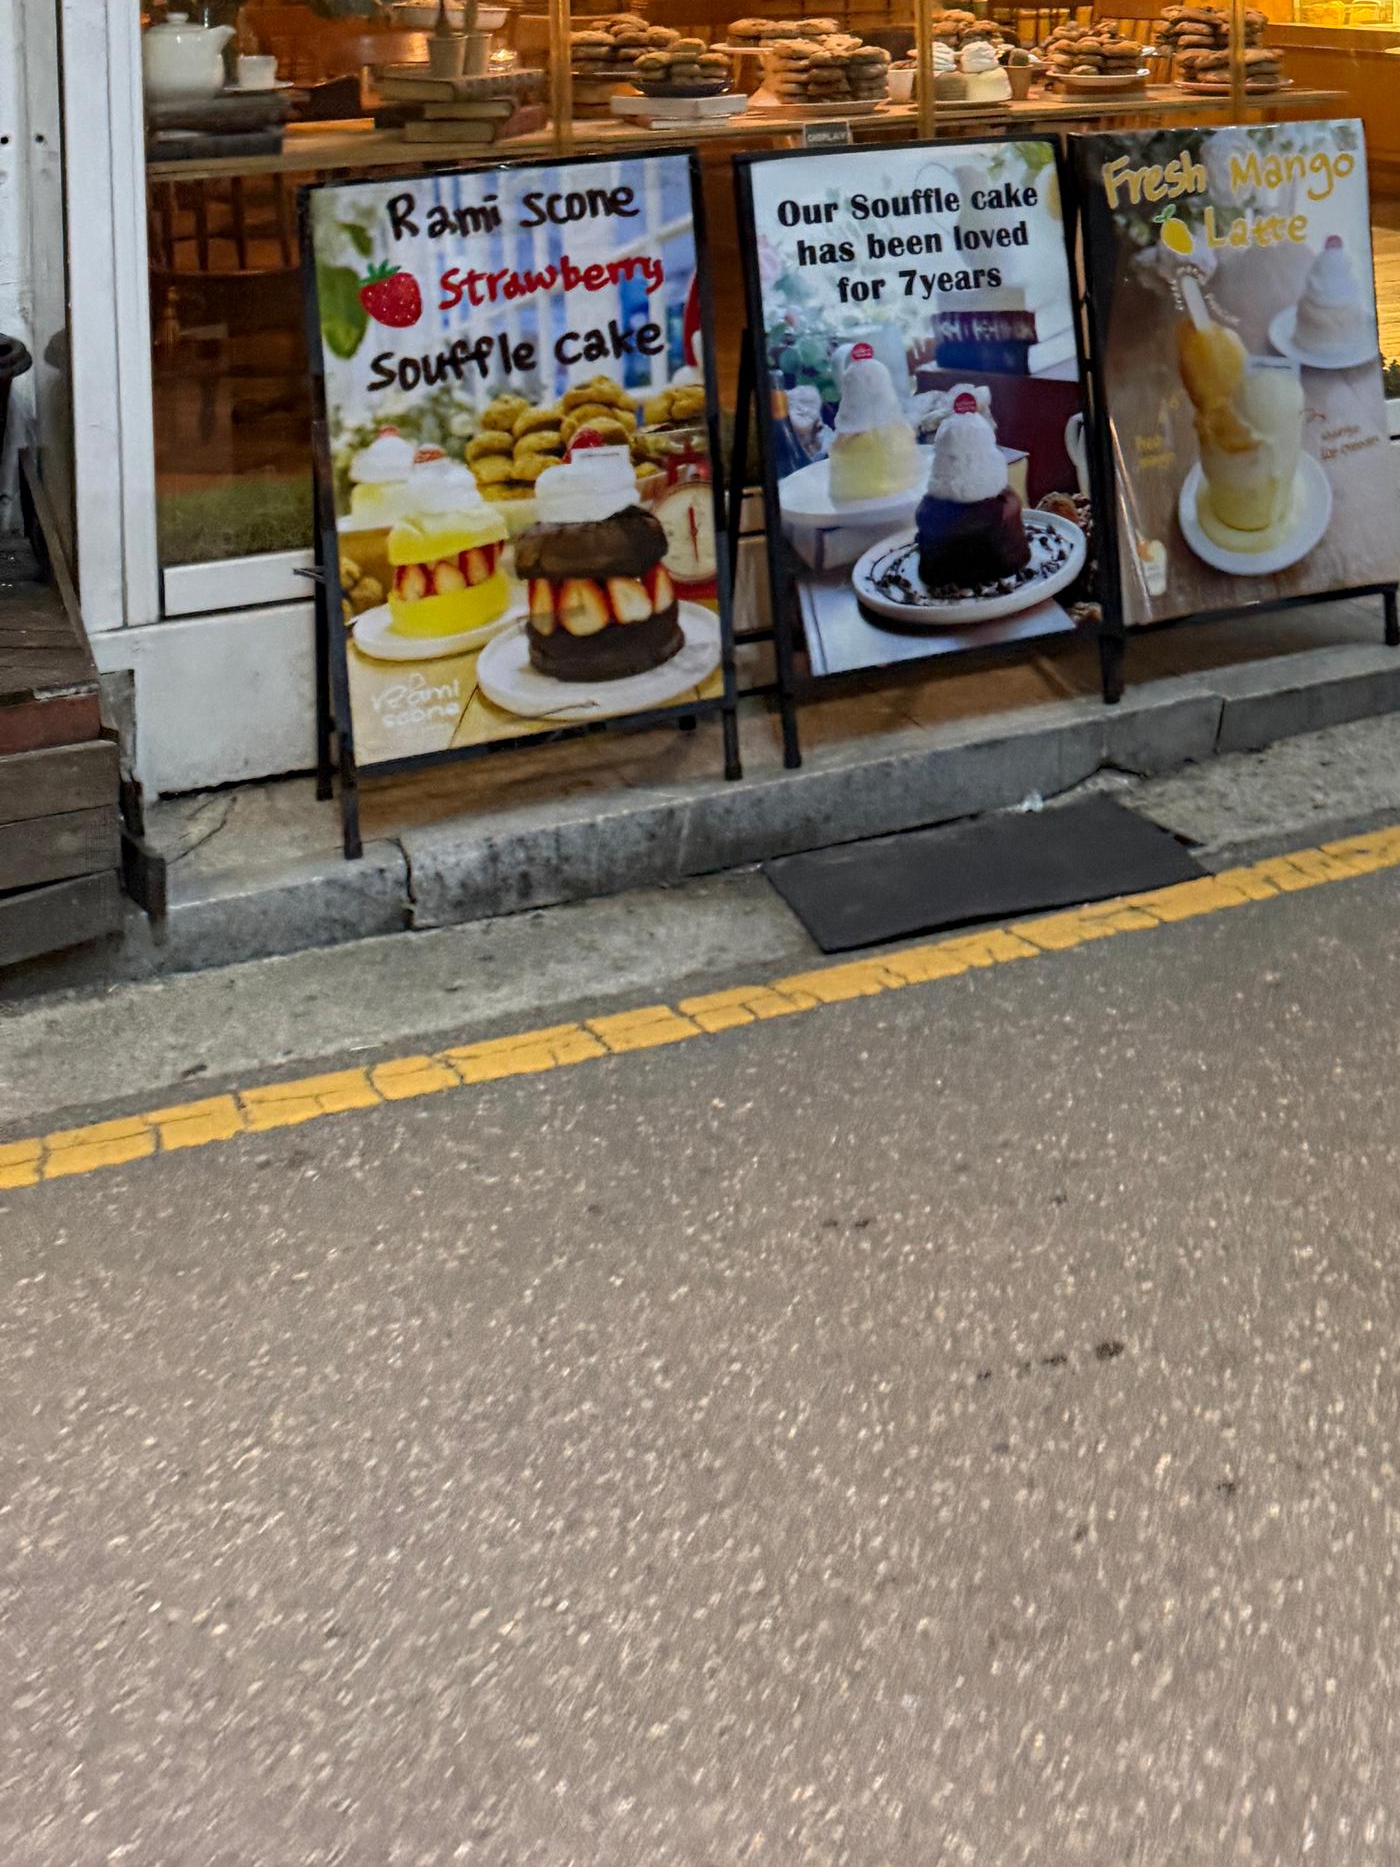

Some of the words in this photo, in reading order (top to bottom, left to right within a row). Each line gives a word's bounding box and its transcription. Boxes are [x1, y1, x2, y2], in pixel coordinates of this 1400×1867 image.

[1103, 149, 1206, 209] Fresh
[1229, 150, 1355, 201] Mango
[387, 192, 502, 241] Rami
[777, 199, 838, 227] Our
[851, 187, 960, 220] Souffle
[971, 182, 1038, 211] cake
[1204, 206, 1308, 248] Latte
[797, 239, 855, 266] has
[867, 232, 942, 259] been
[953, 220, 1029, 251] loved
[438, 255, 664, 310] Strawberry
[837, 276, 886, 303] for
[367, 332, 536, 392] Souffle
